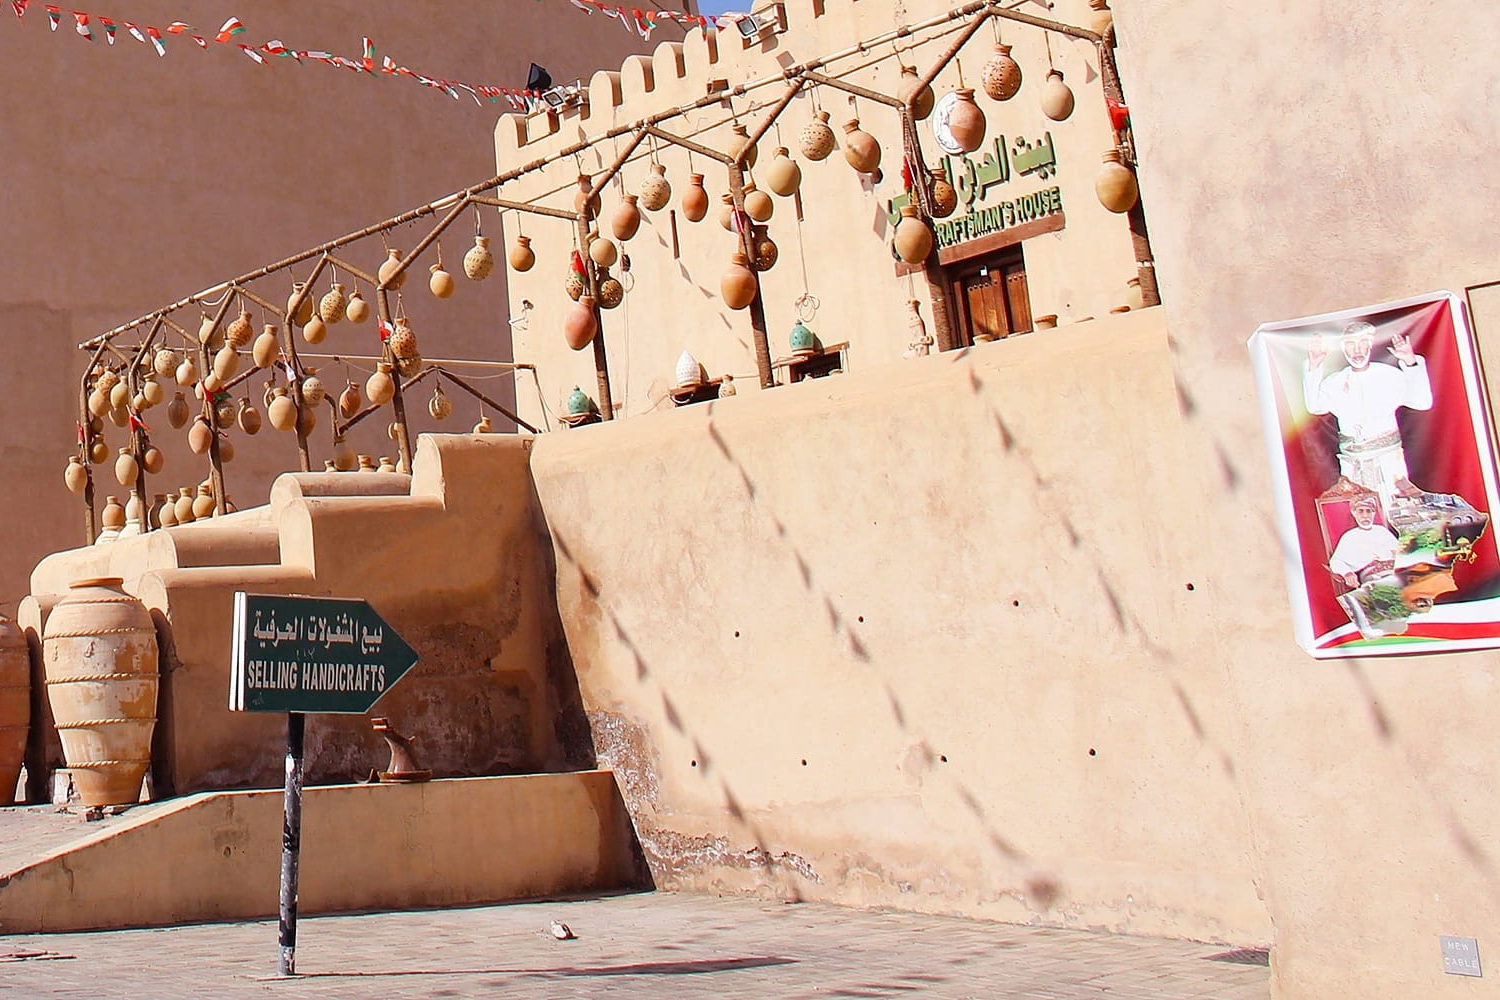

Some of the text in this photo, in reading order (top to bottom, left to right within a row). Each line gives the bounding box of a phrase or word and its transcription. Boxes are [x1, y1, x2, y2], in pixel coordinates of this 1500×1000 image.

[1012, 131, 1056, 180] بيت
[934, 186, 1063, 249] RAFTSMAN'S HOUSE
[253, 609, 383, 655] بيع المشغولات الحرفية
[247, 660, 386, 693] SELLING HANDICRAFTS
[1443, 956, 1478, 969] CABLE
